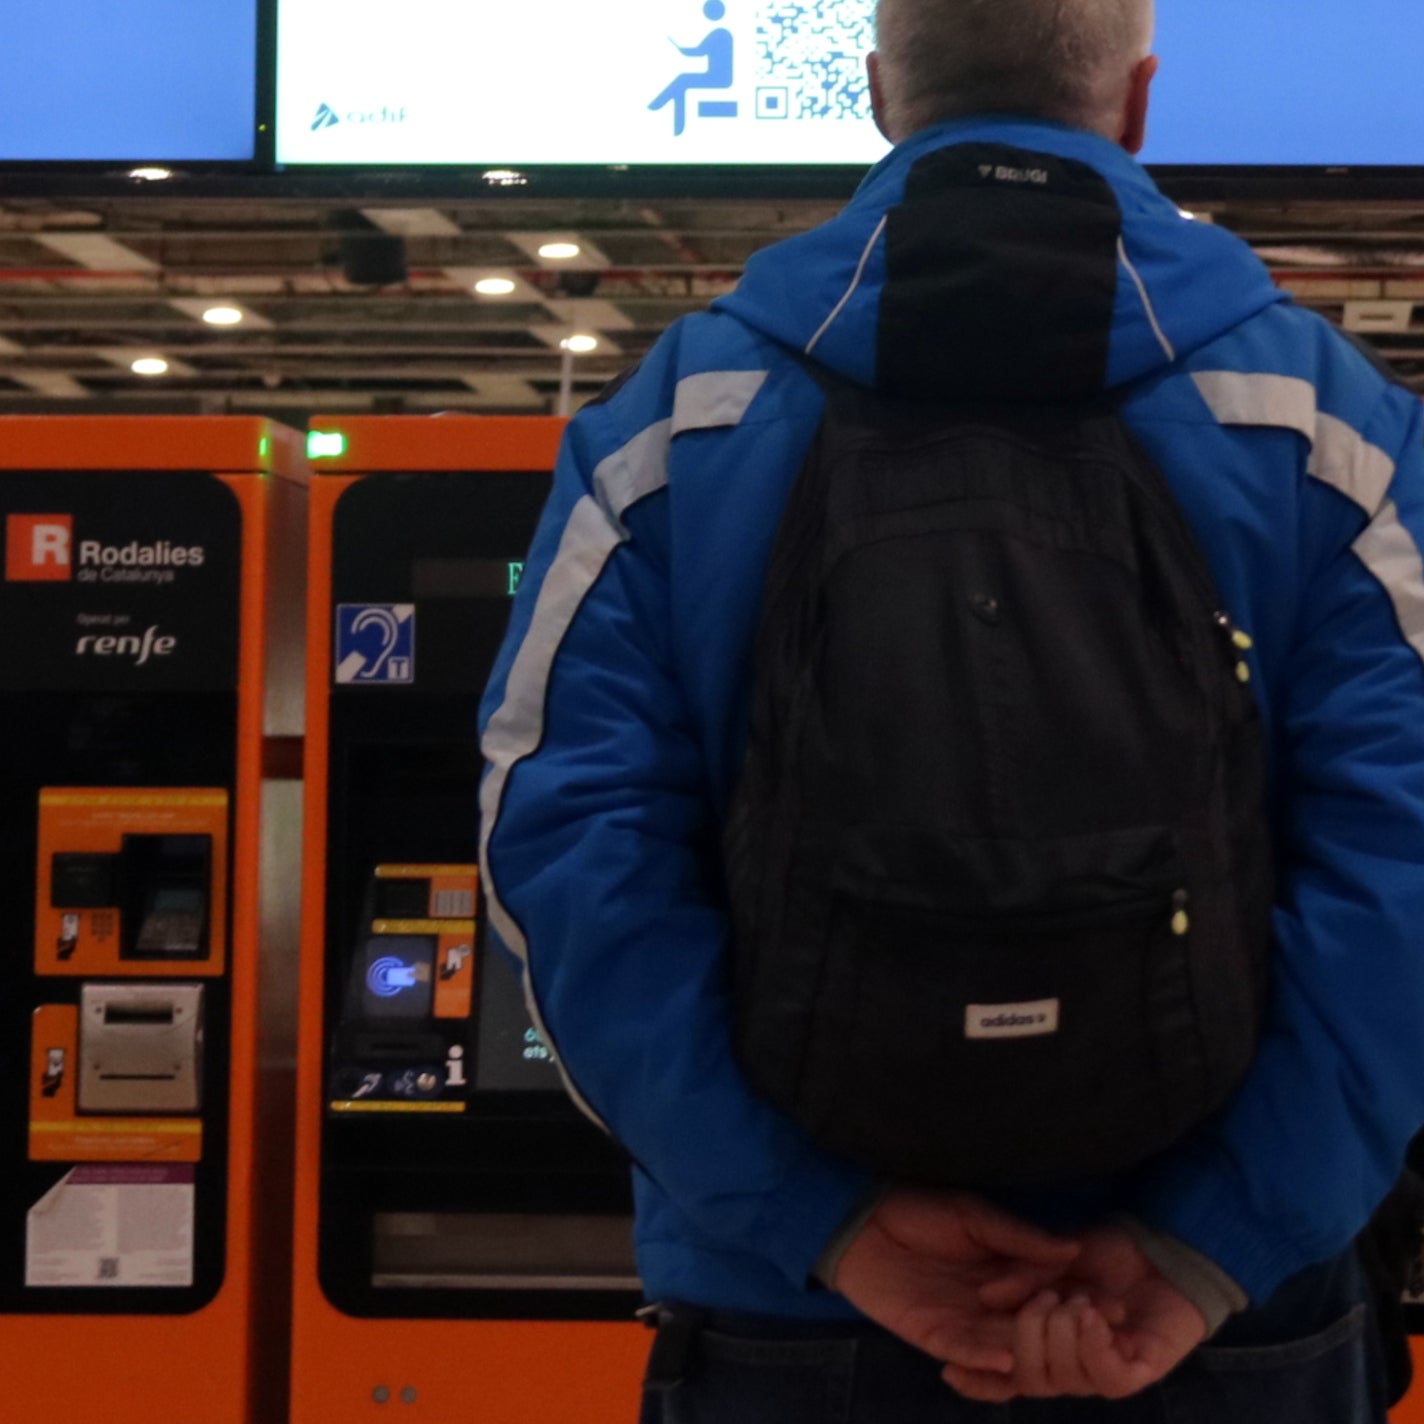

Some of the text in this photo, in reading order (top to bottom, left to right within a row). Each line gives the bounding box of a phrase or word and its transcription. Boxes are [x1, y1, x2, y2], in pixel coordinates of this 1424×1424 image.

[31, 524, 69, 565] R
[80, 541, 205, 566] Rodalies
[76, 625, 176, 665] renfe
[981, 1013, 1034, 1027] adidas
